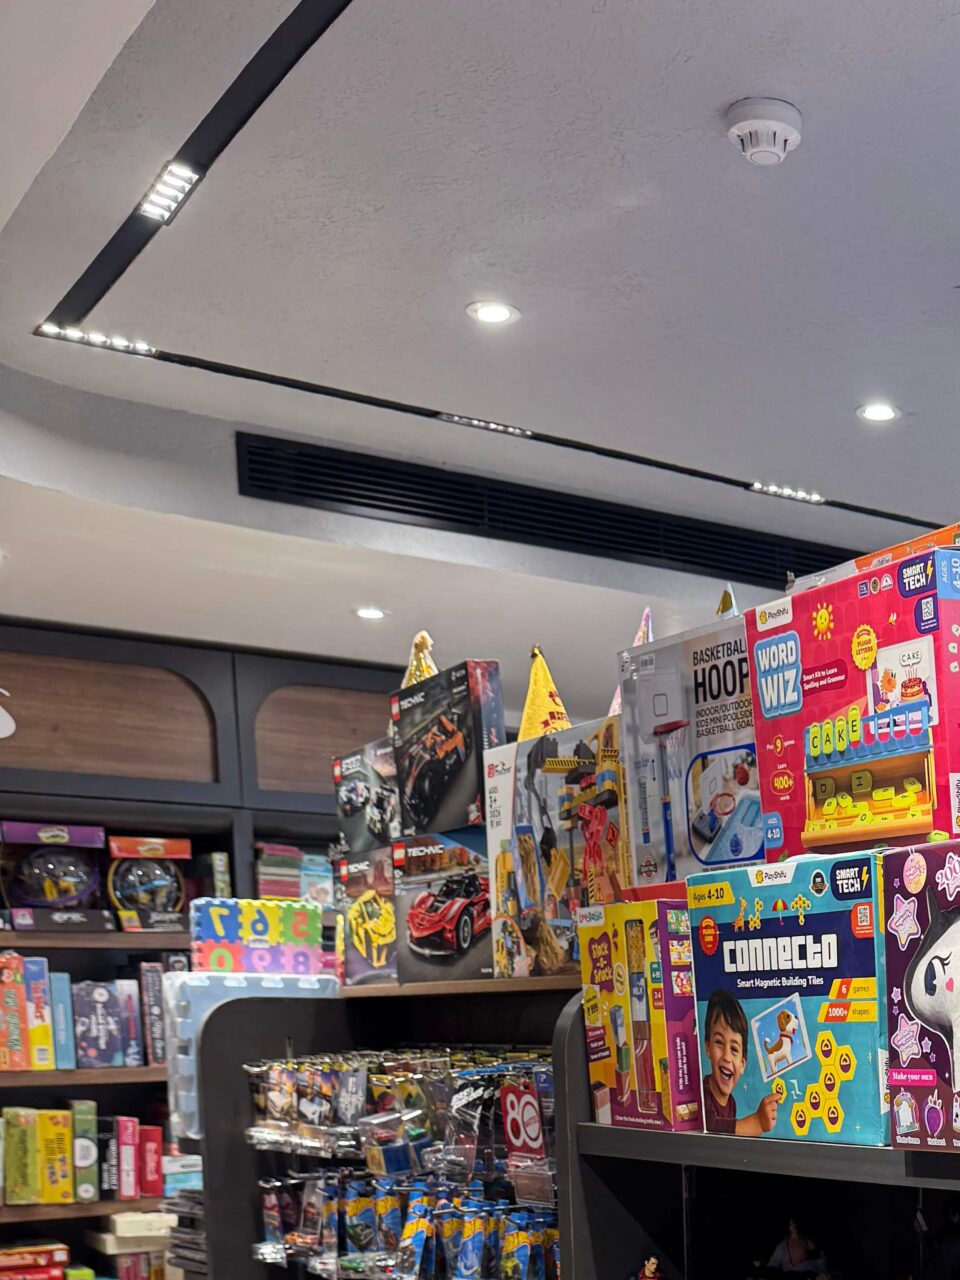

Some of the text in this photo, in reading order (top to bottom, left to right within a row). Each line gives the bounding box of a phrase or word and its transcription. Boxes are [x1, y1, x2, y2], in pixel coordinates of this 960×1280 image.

[903, 563, 924, 578] SMART
[952, 558, 960, 588] 4-10
[903, 575, 926, 591] TECH
[767, 608, 789, 620] PlayShifu
[758, 641, 797, 672] WORD
[901, 651, 920, 663] CAKE
[693, 657, 749, 704] HOOP
[760, 669, 799, 709] WIZ
[811, 719, 859, 749] CAKE
[774, 775, 793, 789] 400+
[767, 829, 780, 839] 4-10
[764, 871, 787, 881] PlayShifu
[836, 867, 859, 880] SMART
[707, 887, 724, 899] 4-10
[837, 879, 861, 894] TECH
[737, 975, 823, 988] Smart Magnetic Building Tiles
[828, 1007, 870, 1017] 1000+ shapes
[506, 1092, 543, 1149] 80
